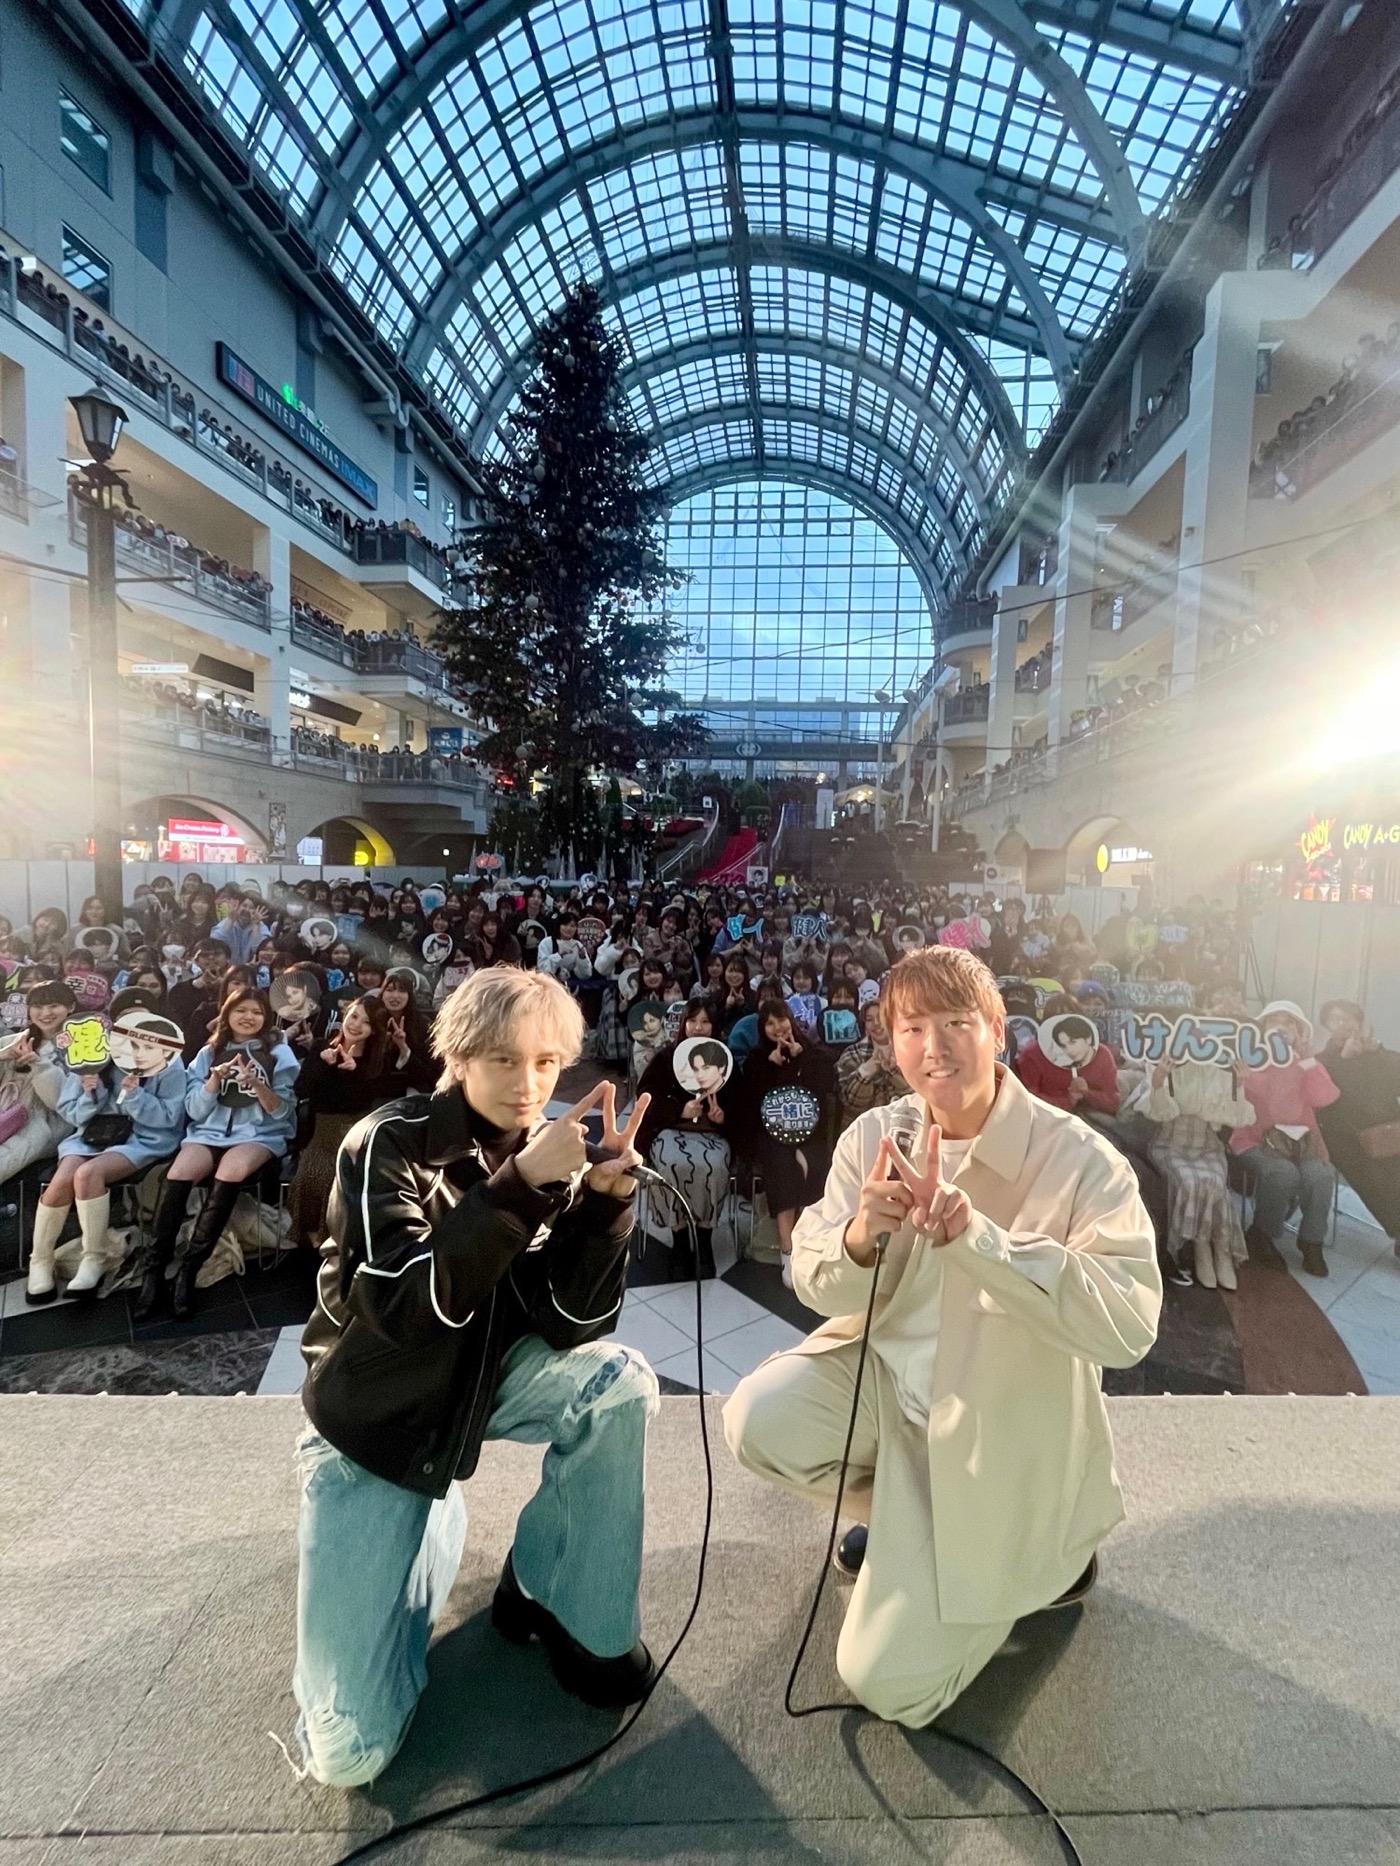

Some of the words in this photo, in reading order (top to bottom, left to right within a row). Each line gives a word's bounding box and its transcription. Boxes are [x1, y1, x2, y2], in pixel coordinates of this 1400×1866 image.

[257, 384, 296, 430] UNITED
[300, 423, 339, 468] CINEMAS
[341, 461, 376, 499] IMAX
[1300, 819, 1330, 862] CANDY
[1343, 823, 1373, 850] CANDY
[128, 1030, 160, 1043] GUCCI
[766, 1092, 798, 1108] これからも
[766, 1102, 814, 1120] 一緒に
